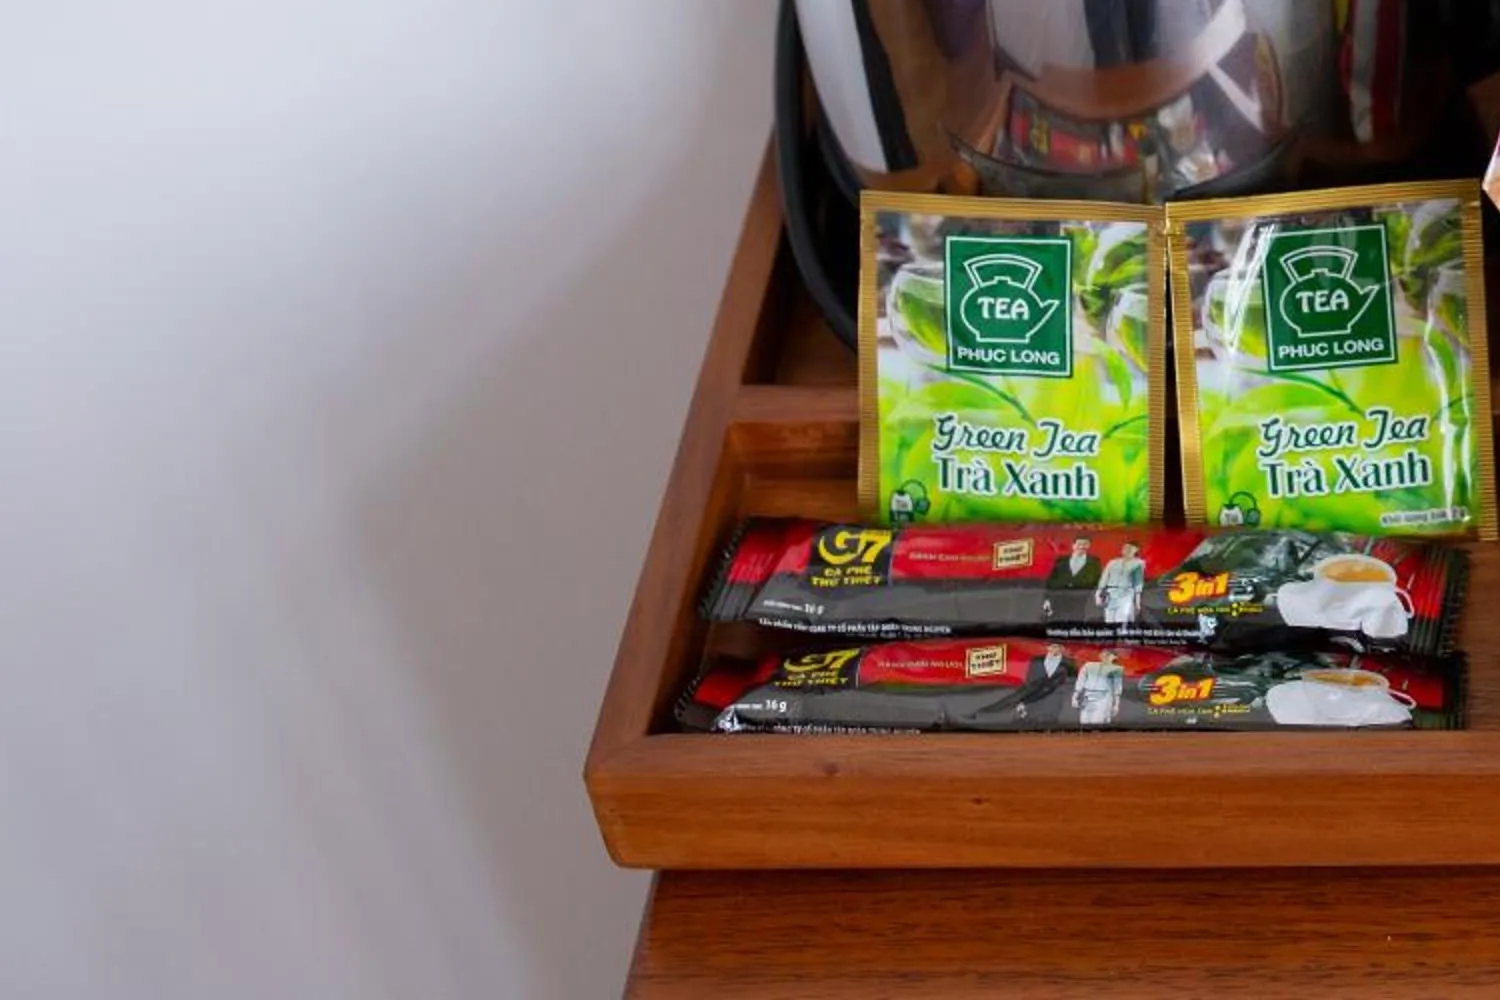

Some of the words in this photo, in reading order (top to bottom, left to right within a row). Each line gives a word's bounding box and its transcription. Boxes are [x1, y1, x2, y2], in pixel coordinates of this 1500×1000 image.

[977, 296, 1030, 321] TEA
[1296, 289, 1349, 313] TEA
[957, 346, 1007, 364] PHUC
[1010, 349, 1061, 366] LONG
[1278, 342, 1330, 359] PHUC
[1334, 338, 1384, 356] LONG
[933, 413, 1026, 452] Green
[1033, 420, 1099, 457] Tea
[1258, 418, 1354, 457] Green
[1364, 409, 1428, 450] Tea
[934, 456, 994, 494] Trà
[1003, 461, 1097, 498] Xanh
[1262, 459, 1325, 496] Trà
[1335, 451, 1430, 491] Xanh
[818, 529, 892, 565] G7
[1168, 571, 1230, 604] 3in1
[1150, 674, 1216, 706] 3in1
